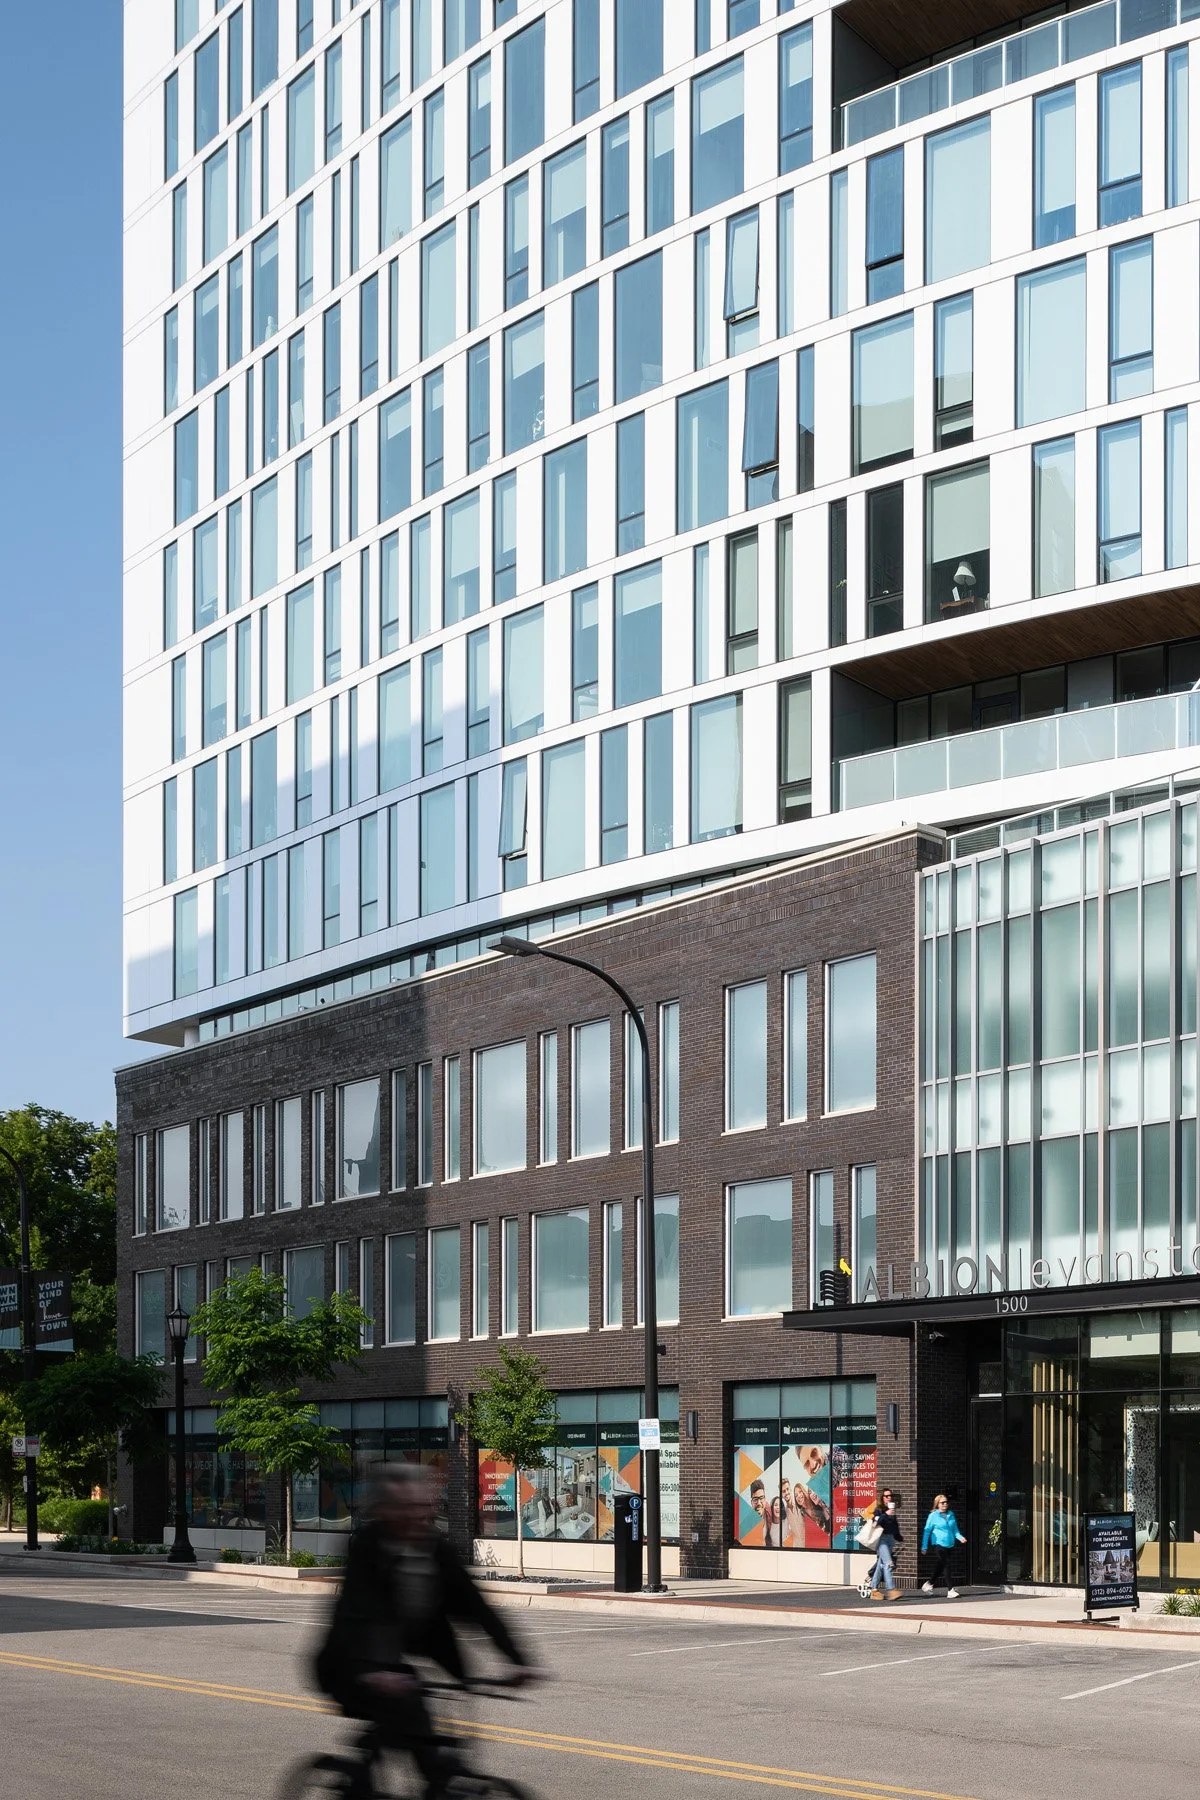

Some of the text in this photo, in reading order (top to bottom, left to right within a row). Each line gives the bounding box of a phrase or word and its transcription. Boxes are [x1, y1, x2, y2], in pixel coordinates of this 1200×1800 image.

[861, 1252, 1009, 1302] ALBION
[39, 1280, 64, 1291] YOUR
[39, 1290, 61, 1299] KIND
[39, 1300, 51, 1308] OF
[994, 1295, 1028, 1313] 1500
[40, 1320, 67, 1331] TOWN
[1106, 1587, 1132, 1595] 894-6072
